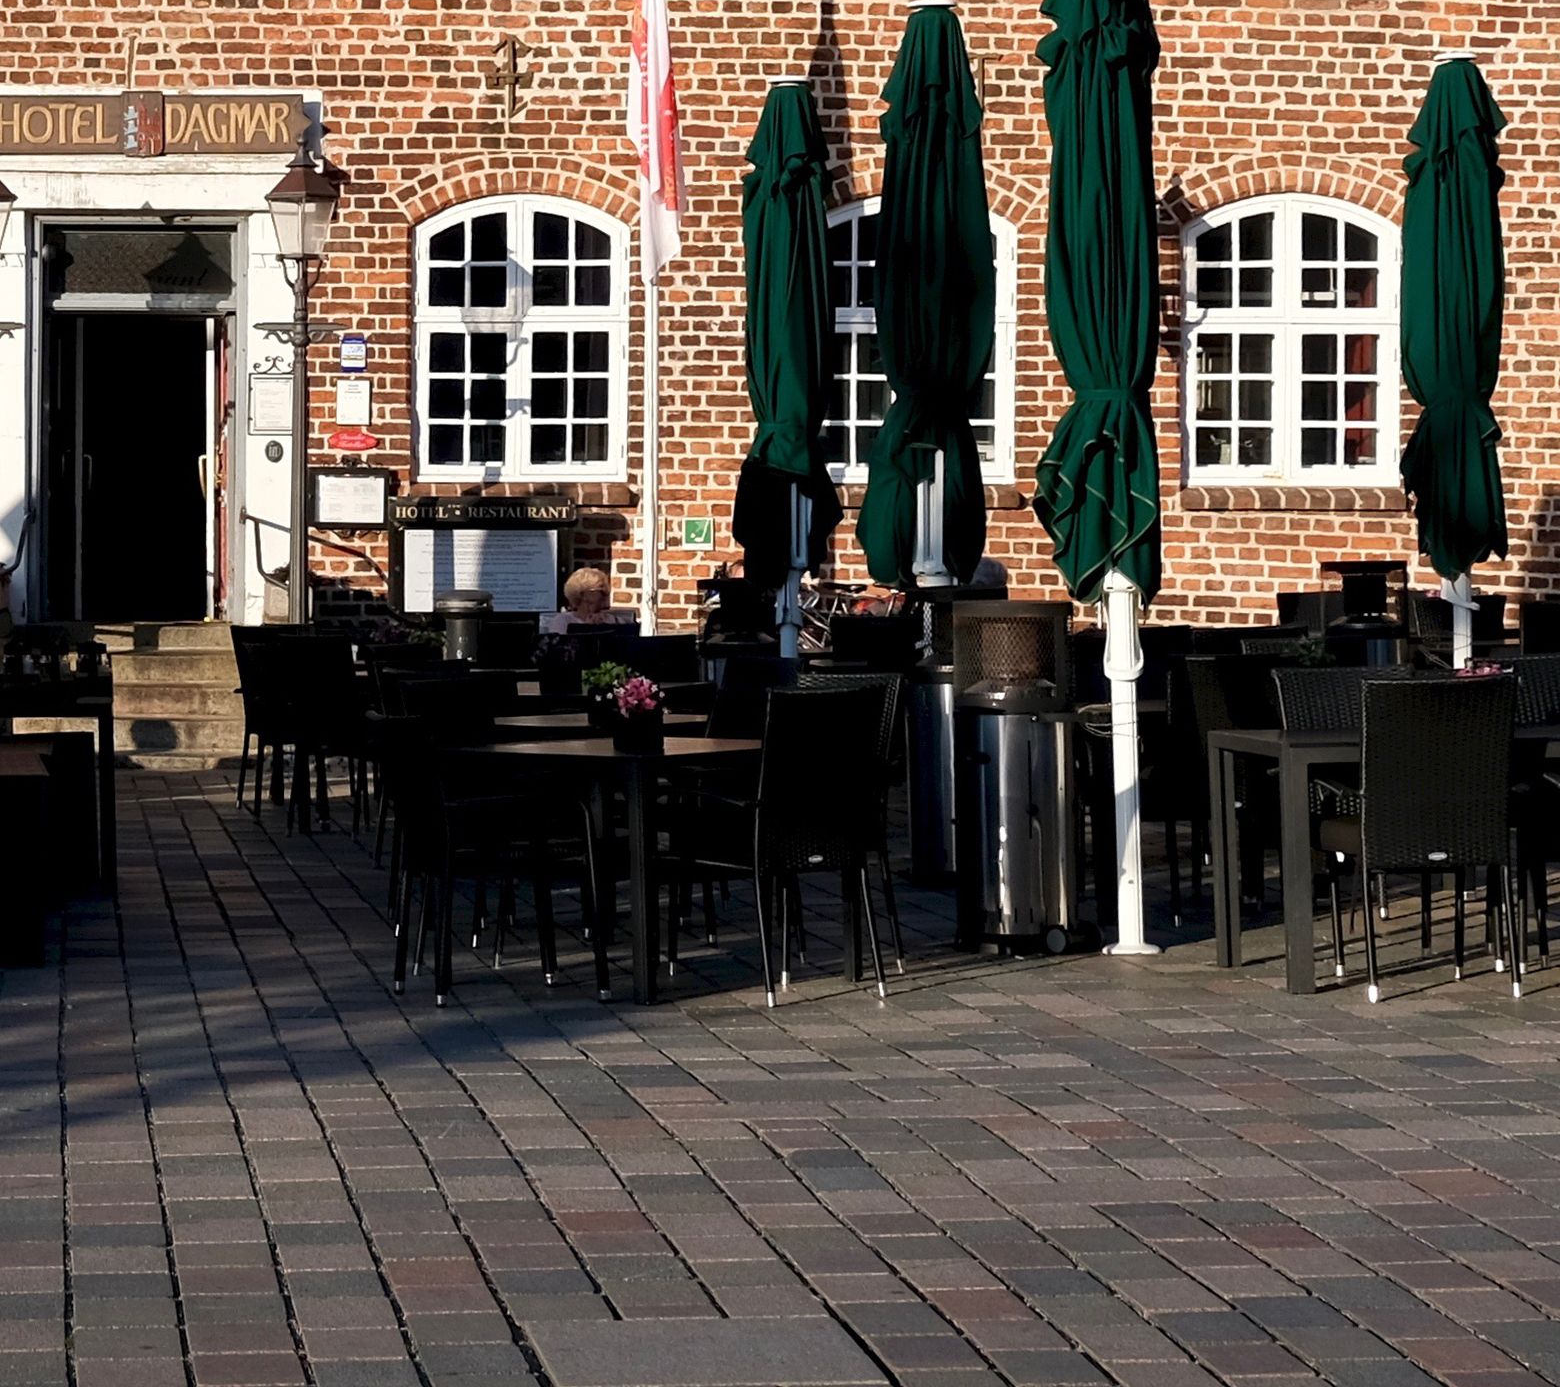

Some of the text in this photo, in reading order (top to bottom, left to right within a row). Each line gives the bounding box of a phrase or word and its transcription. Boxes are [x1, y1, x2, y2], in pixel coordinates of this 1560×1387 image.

[165, 102, 292, 145] DAGMAR
[395, 506, 570, 519] HOTEL RESTAURANT
